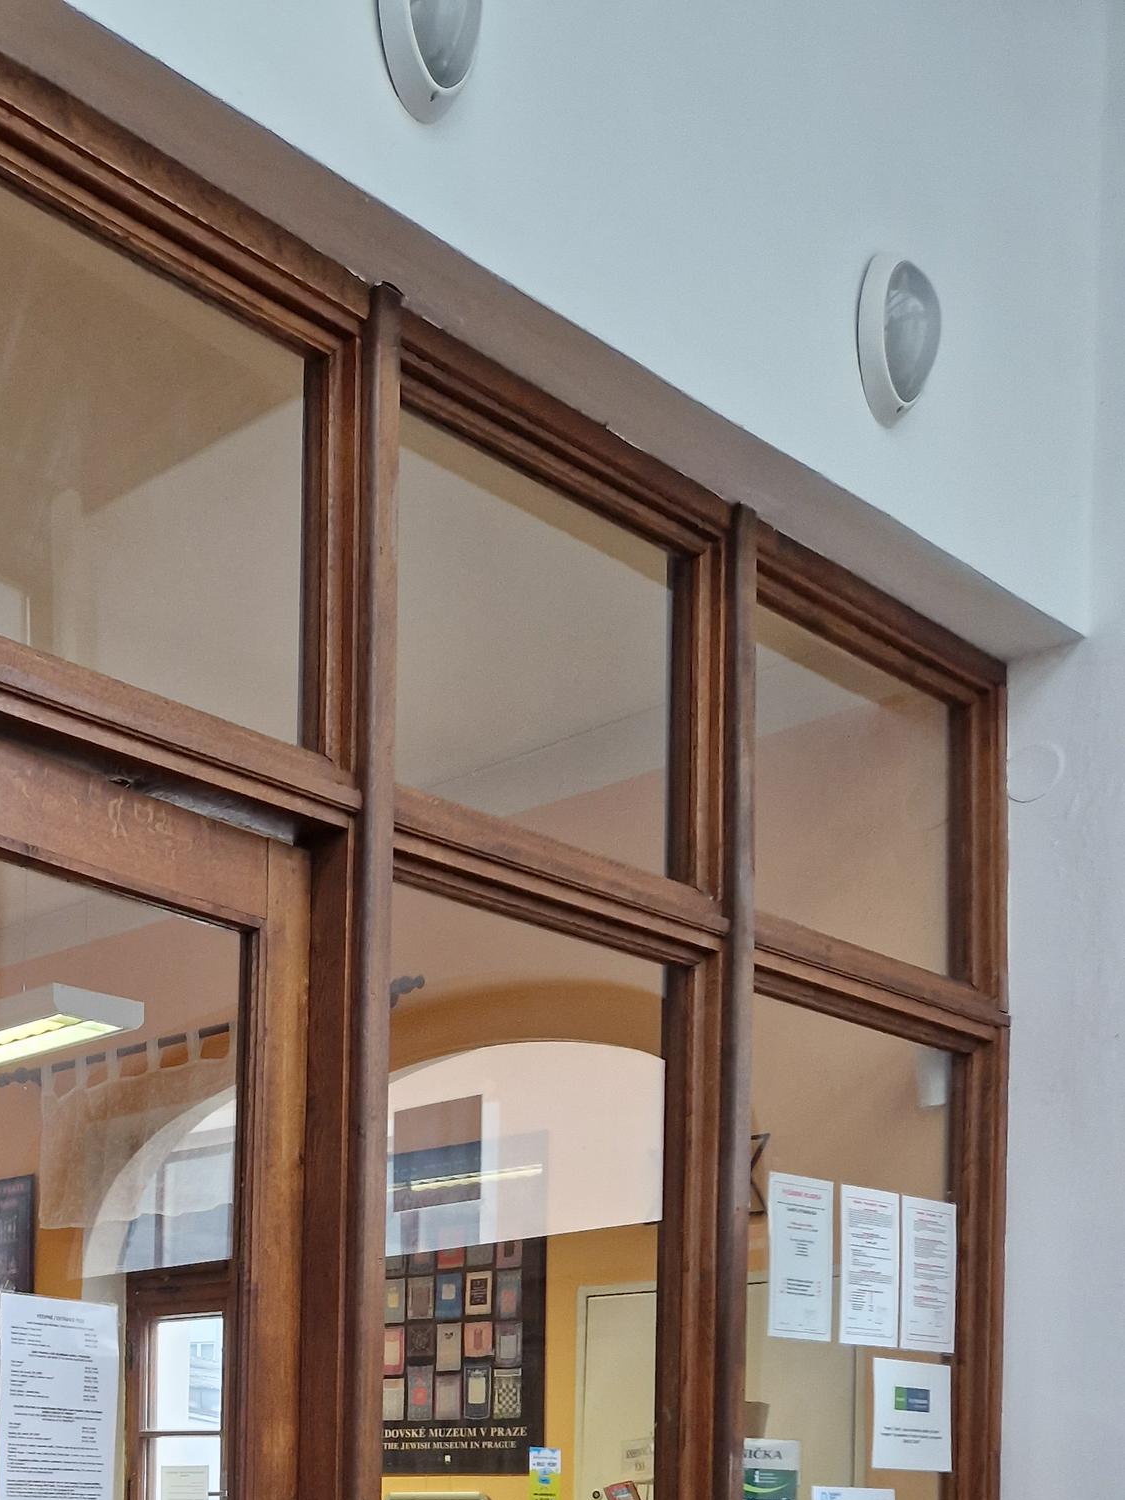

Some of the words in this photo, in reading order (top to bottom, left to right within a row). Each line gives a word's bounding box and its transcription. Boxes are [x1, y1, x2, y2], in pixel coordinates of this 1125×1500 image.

[384, 1426, 426, 1438] DOVSKÉ
[428, 1427, 477, 1438] MUZEUM
[479, 1427, 488, 1437] V
[490, 1426, 528, 1437] PRAZE
[383, 1442, 399, 1450] THE
[400, 1442, 431, 1450] JEWISH
[432, 1441, 469, 1449] MUSEUM
[470, 1441, 480, 1449] IN
[482, 1441, 517, 1449] PRAGUE
